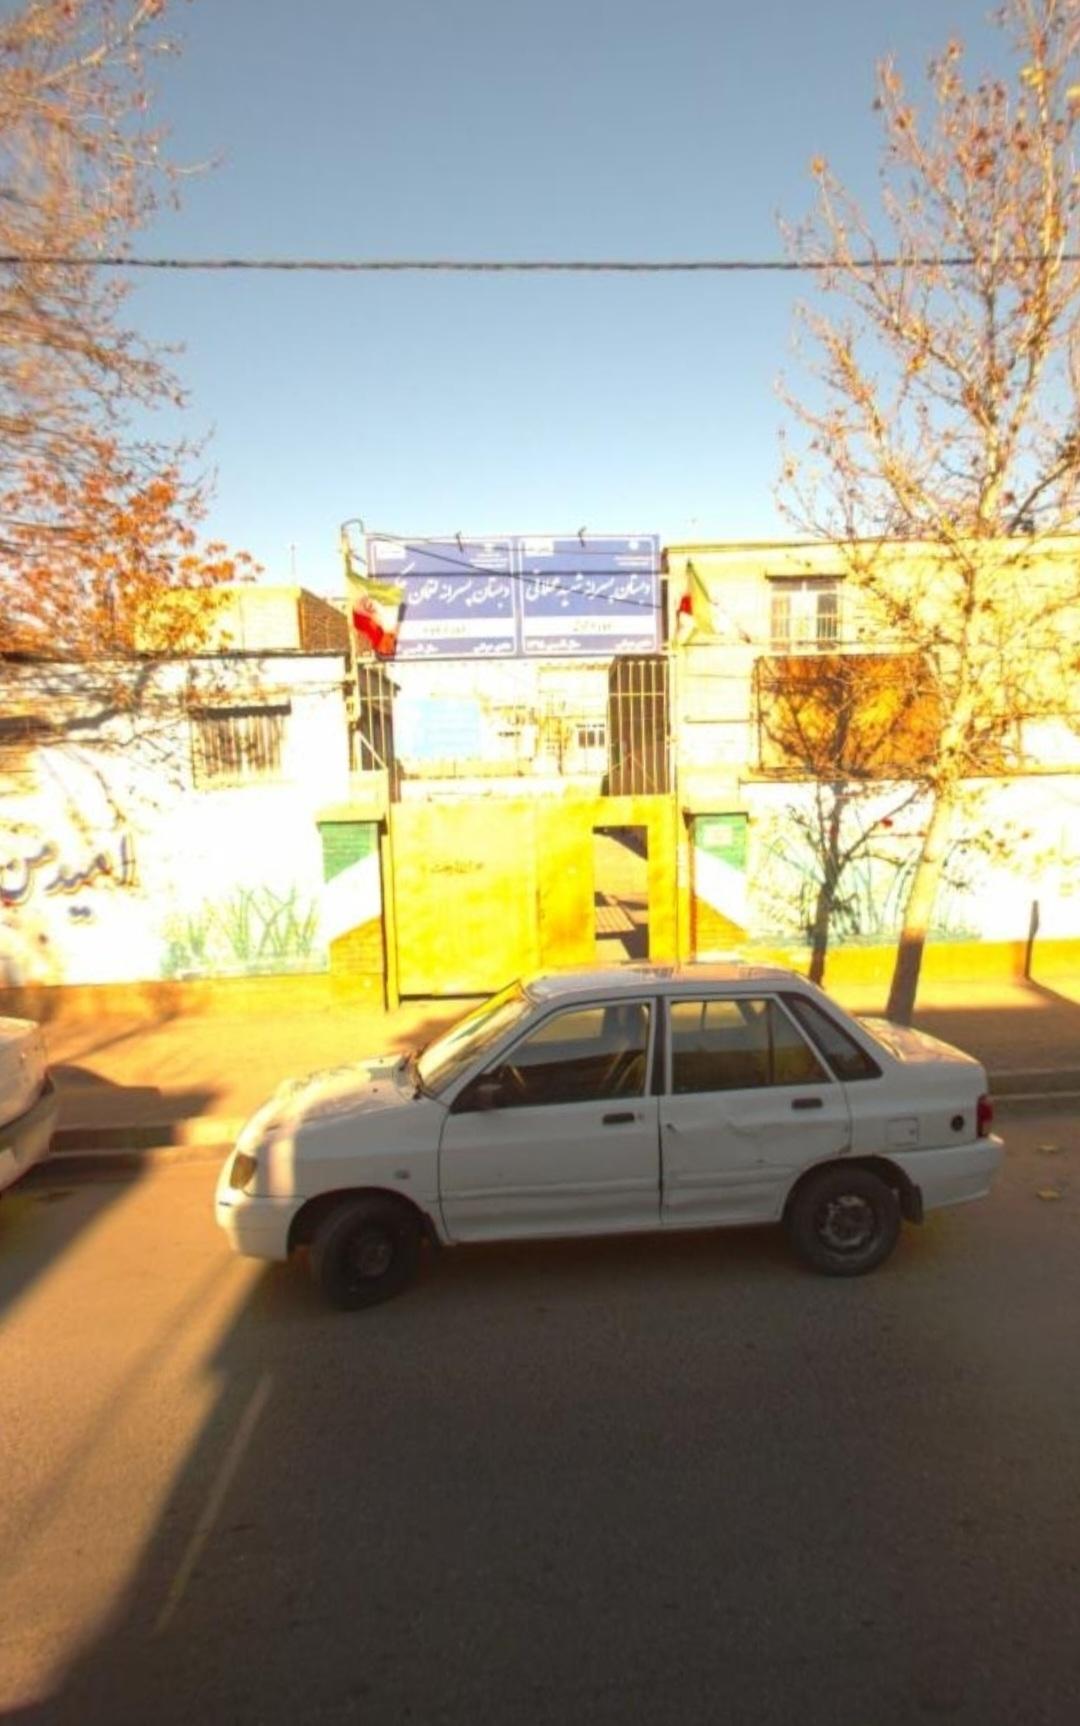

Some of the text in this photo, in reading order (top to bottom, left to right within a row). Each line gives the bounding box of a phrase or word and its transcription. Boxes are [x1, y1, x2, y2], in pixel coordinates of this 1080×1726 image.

[471, 577, 510, 609] دبستان
[613, 573, 651, 605] دبستان
[44, 834, 136, 920] امید
